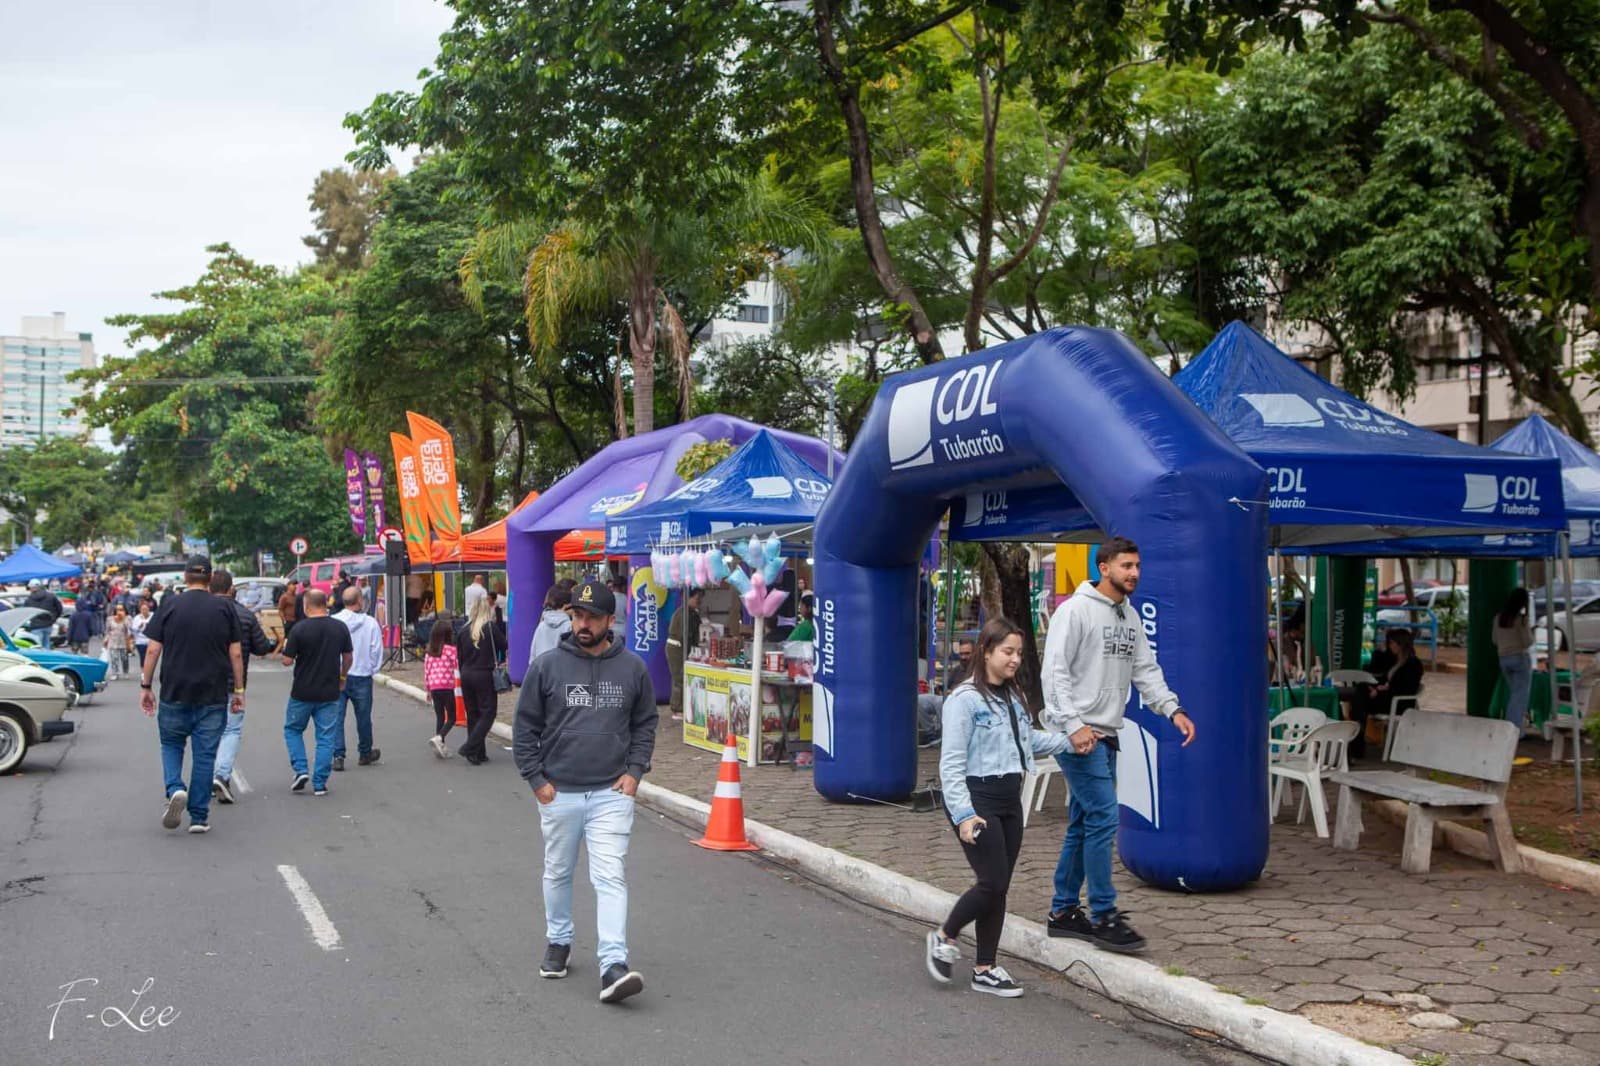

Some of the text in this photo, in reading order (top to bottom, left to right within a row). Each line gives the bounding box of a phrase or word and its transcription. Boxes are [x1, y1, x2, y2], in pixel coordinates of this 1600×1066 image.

[936, 359, 1003, 425] CDL
[1316, 398, 1396, 426] CDL
[939, 429, 1005, 462] Tubarão
[985, 490, 1008, 511] CDL
[1501, 476, 1541, 500] CDL
[1269, 496, 1306, 508] ubarão
[1502, 503, 1540, 515] Tubarão
[635, 583, 649, 652] NATIVA
[822, 600, 835, 675] Tubarão
[1103, 625, 1136, 641] GANG
